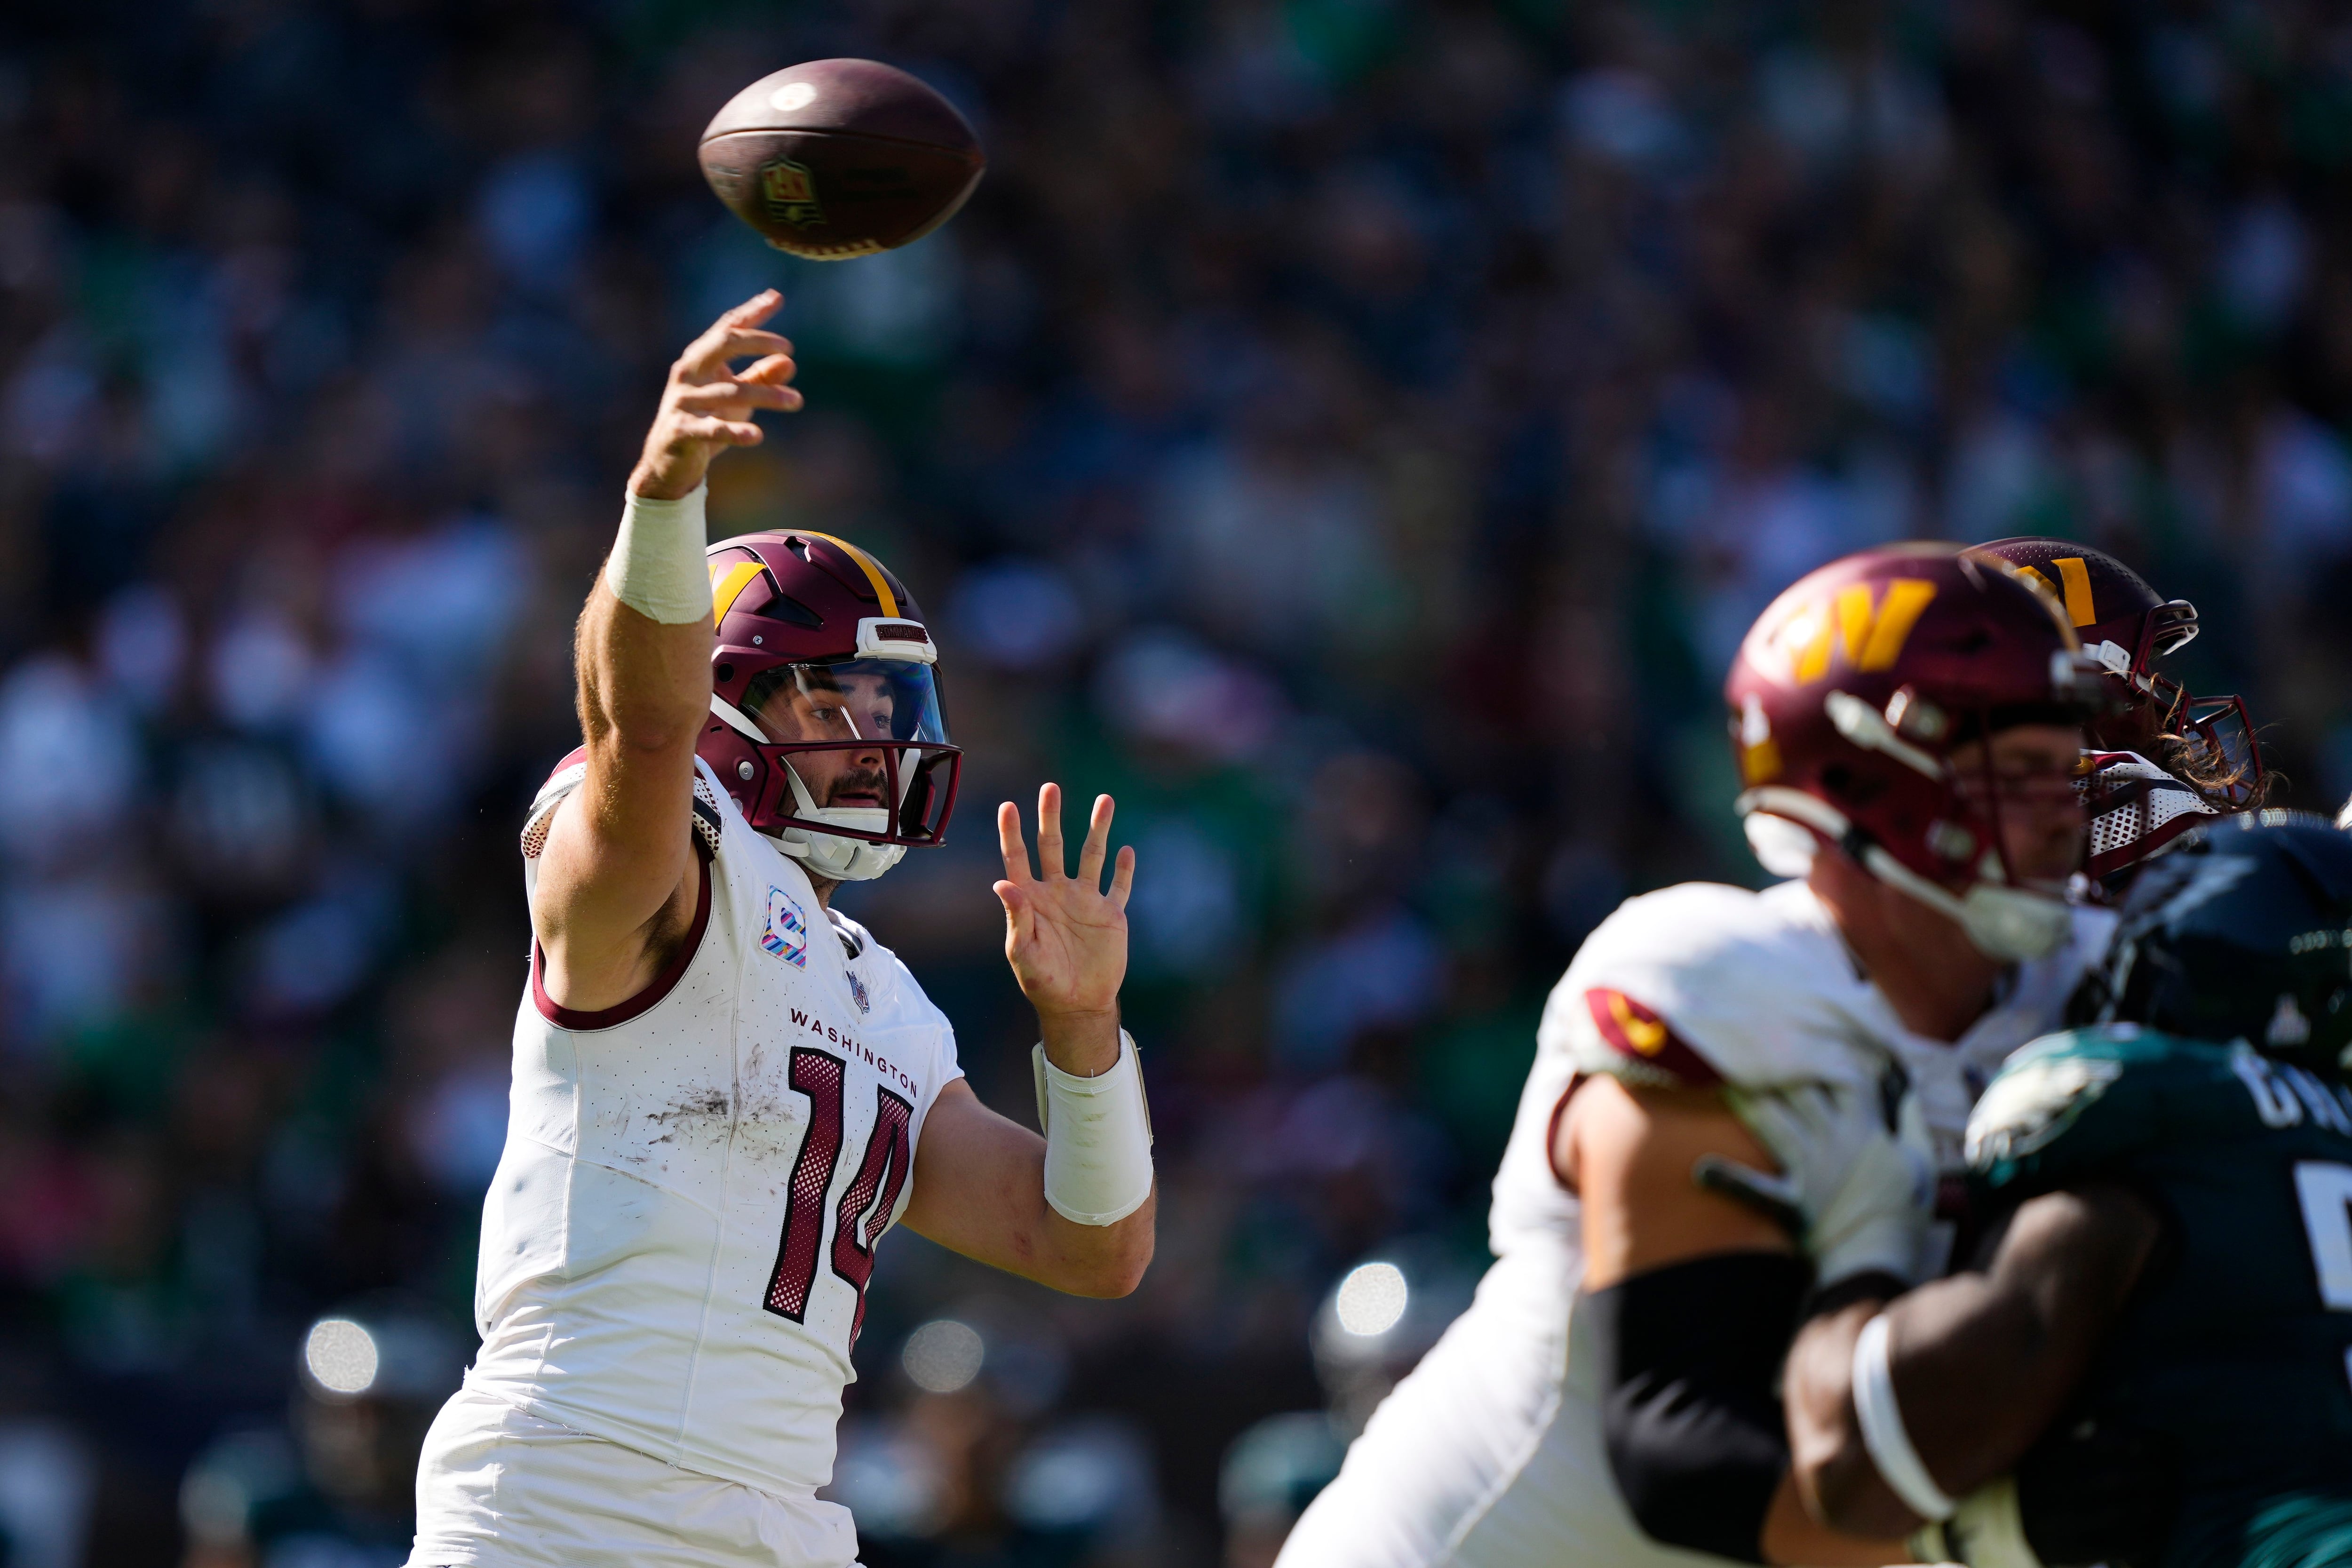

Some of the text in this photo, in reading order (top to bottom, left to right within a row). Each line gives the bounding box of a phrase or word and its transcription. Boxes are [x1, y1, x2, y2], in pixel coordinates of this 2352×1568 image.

[770, 890, 805, 950] C
[852, 982, 868, 1006] NFL
[791, 1008, 918, 1098] WASHINGTON
[763, 1045, 914, 1359] 14
